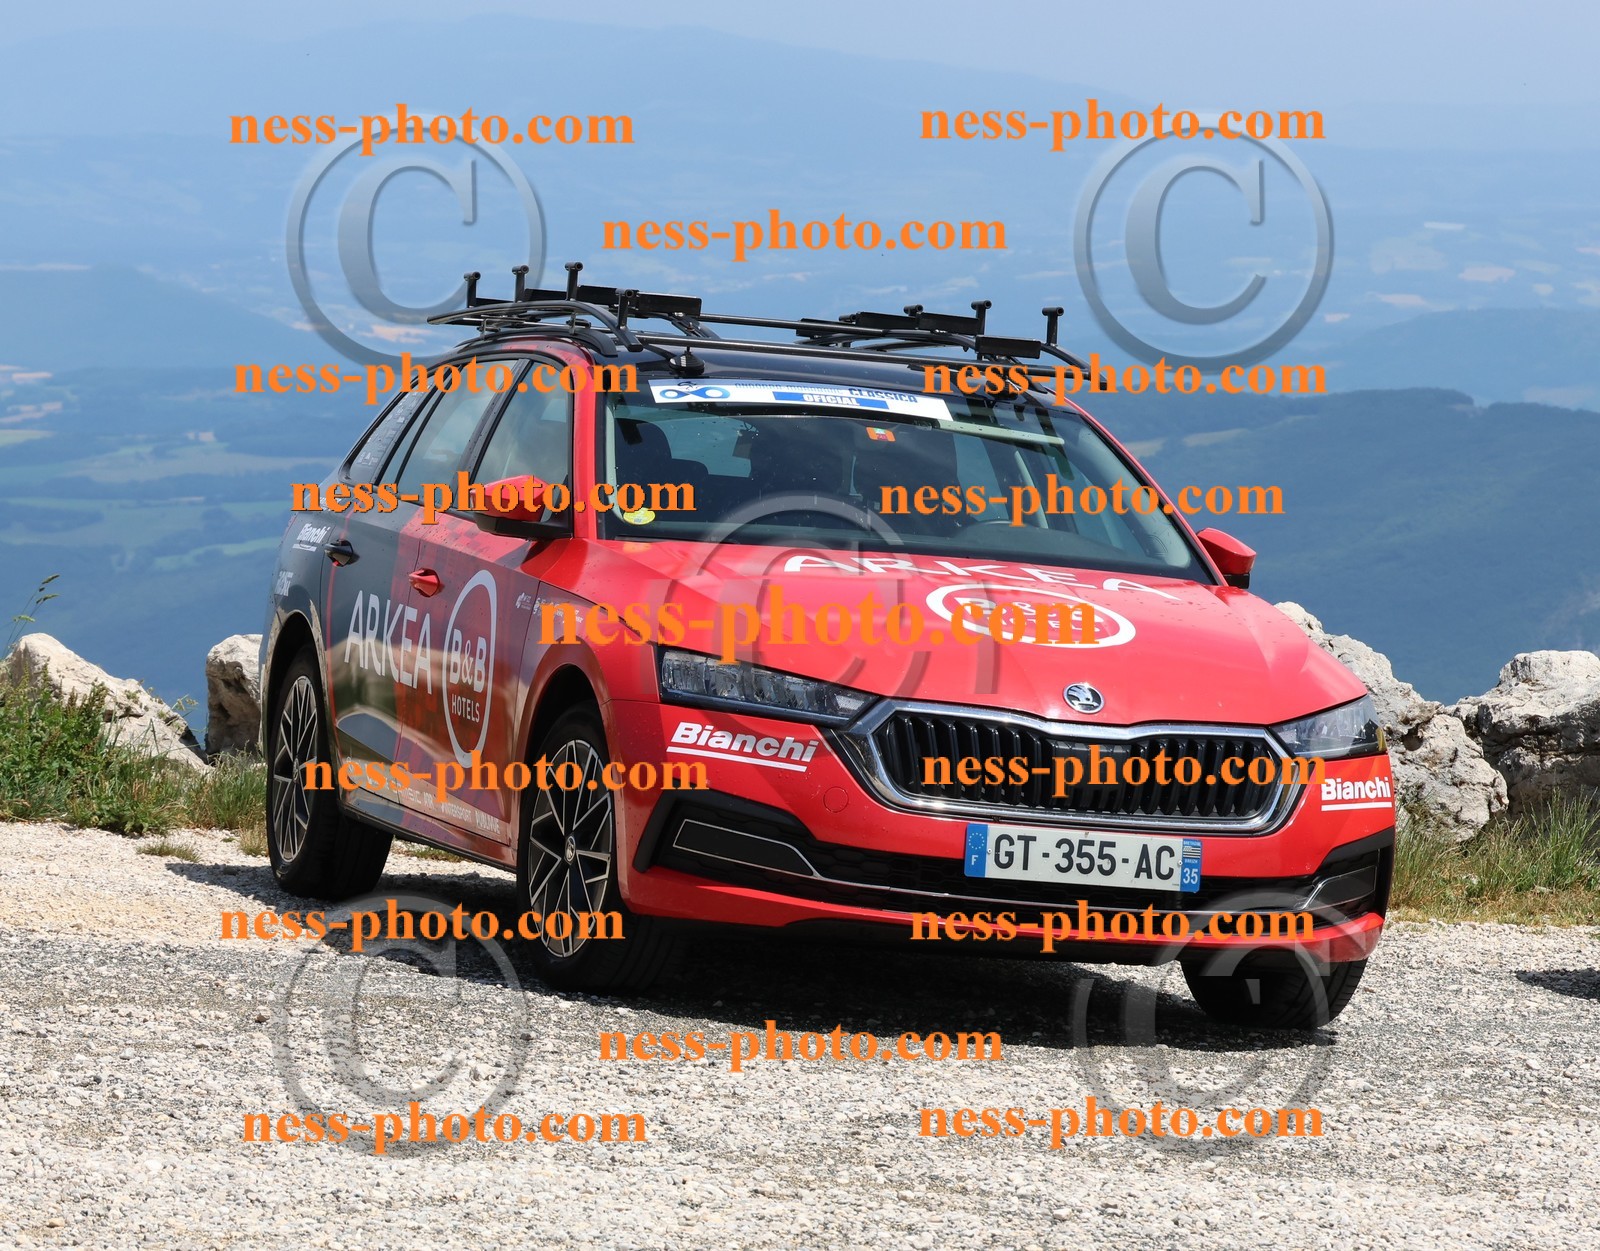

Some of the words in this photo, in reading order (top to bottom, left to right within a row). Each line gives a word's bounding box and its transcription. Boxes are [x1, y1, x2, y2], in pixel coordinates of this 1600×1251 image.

[802, 393, 860, 407] OFICIAL
[784, 554, 1182, 600] ARKEA
[344, 589, 432, 695] ARKEA
[449, 628, 487, 693] B&B
[451, 693, 480, 724] HOTELS
[670, 721, 820, 763] Bianchi
[1320, 776, 1392, 801] Bianchi
[971, 854, 979, 866] F
[993, 833, 1175, 881] GT-355-AC
[1182, 867, 1199, 885] 35
